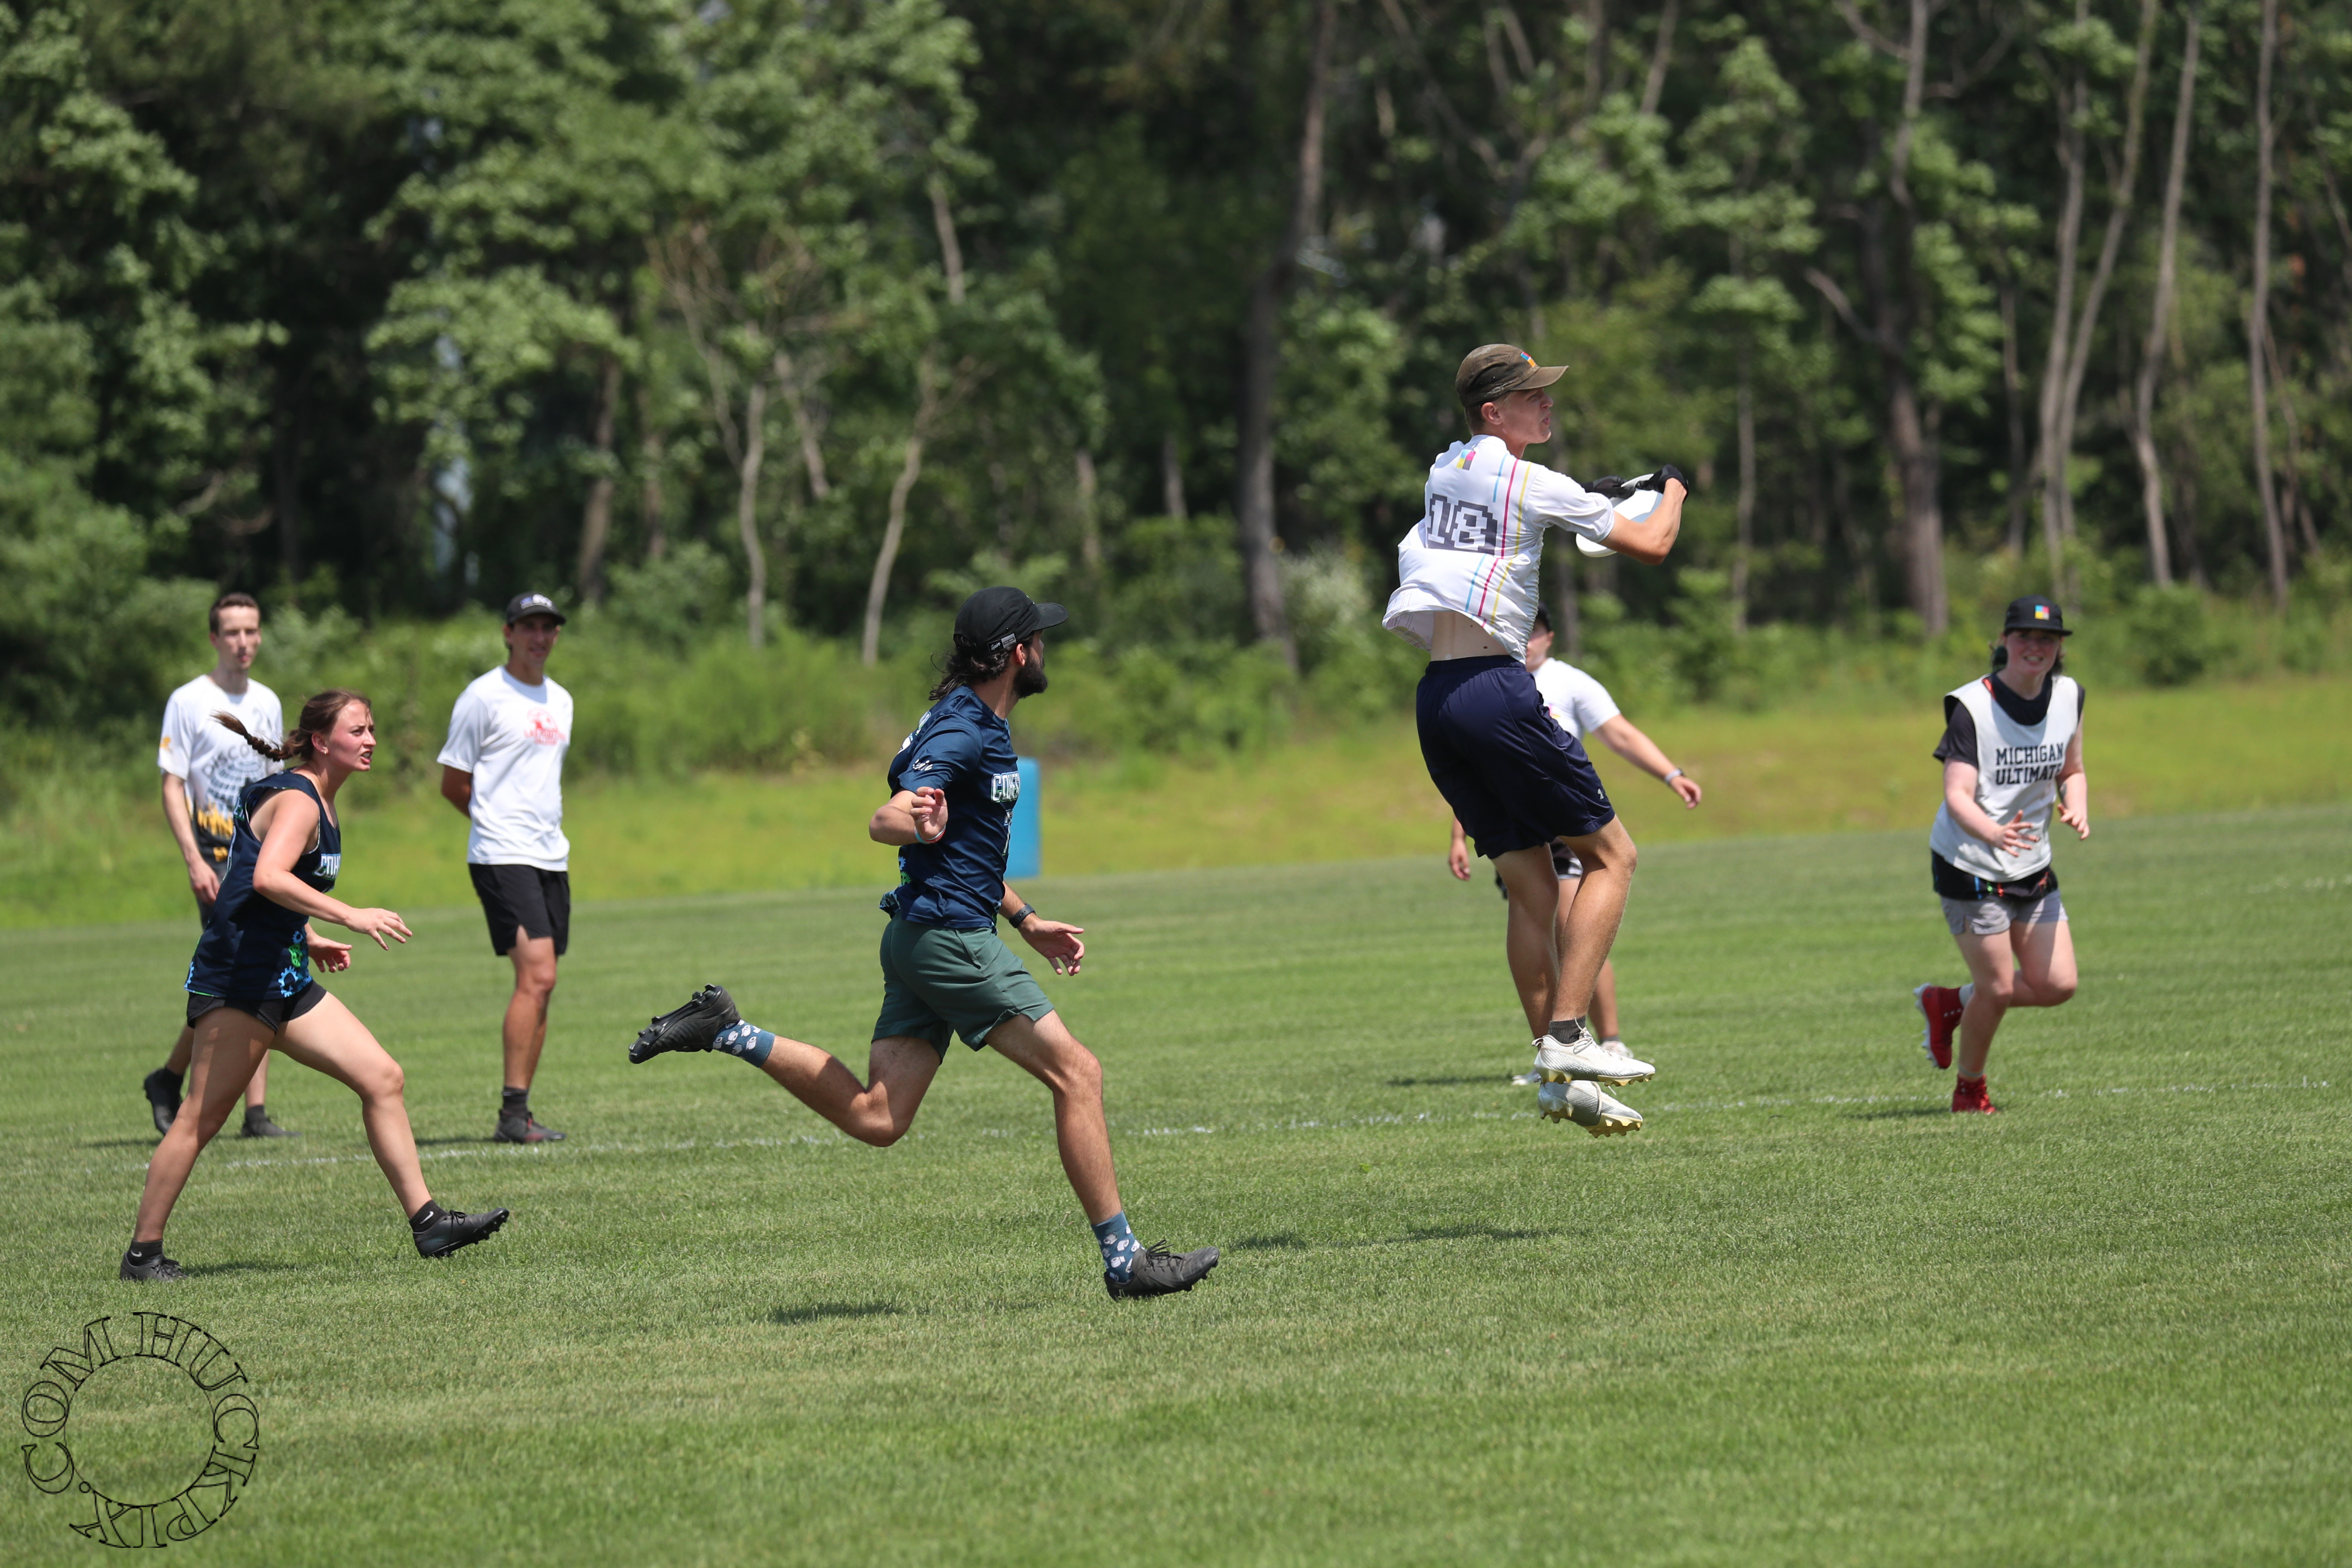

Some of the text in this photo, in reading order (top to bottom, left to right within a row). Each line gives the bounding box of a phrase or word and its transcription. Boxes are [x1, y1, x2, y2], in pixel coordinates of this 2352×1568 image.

[1427, 494, 1497, 554] 18
[1996, 743, 2063, 765] MICHIGAN
[312, 854, 342, 881] COH
